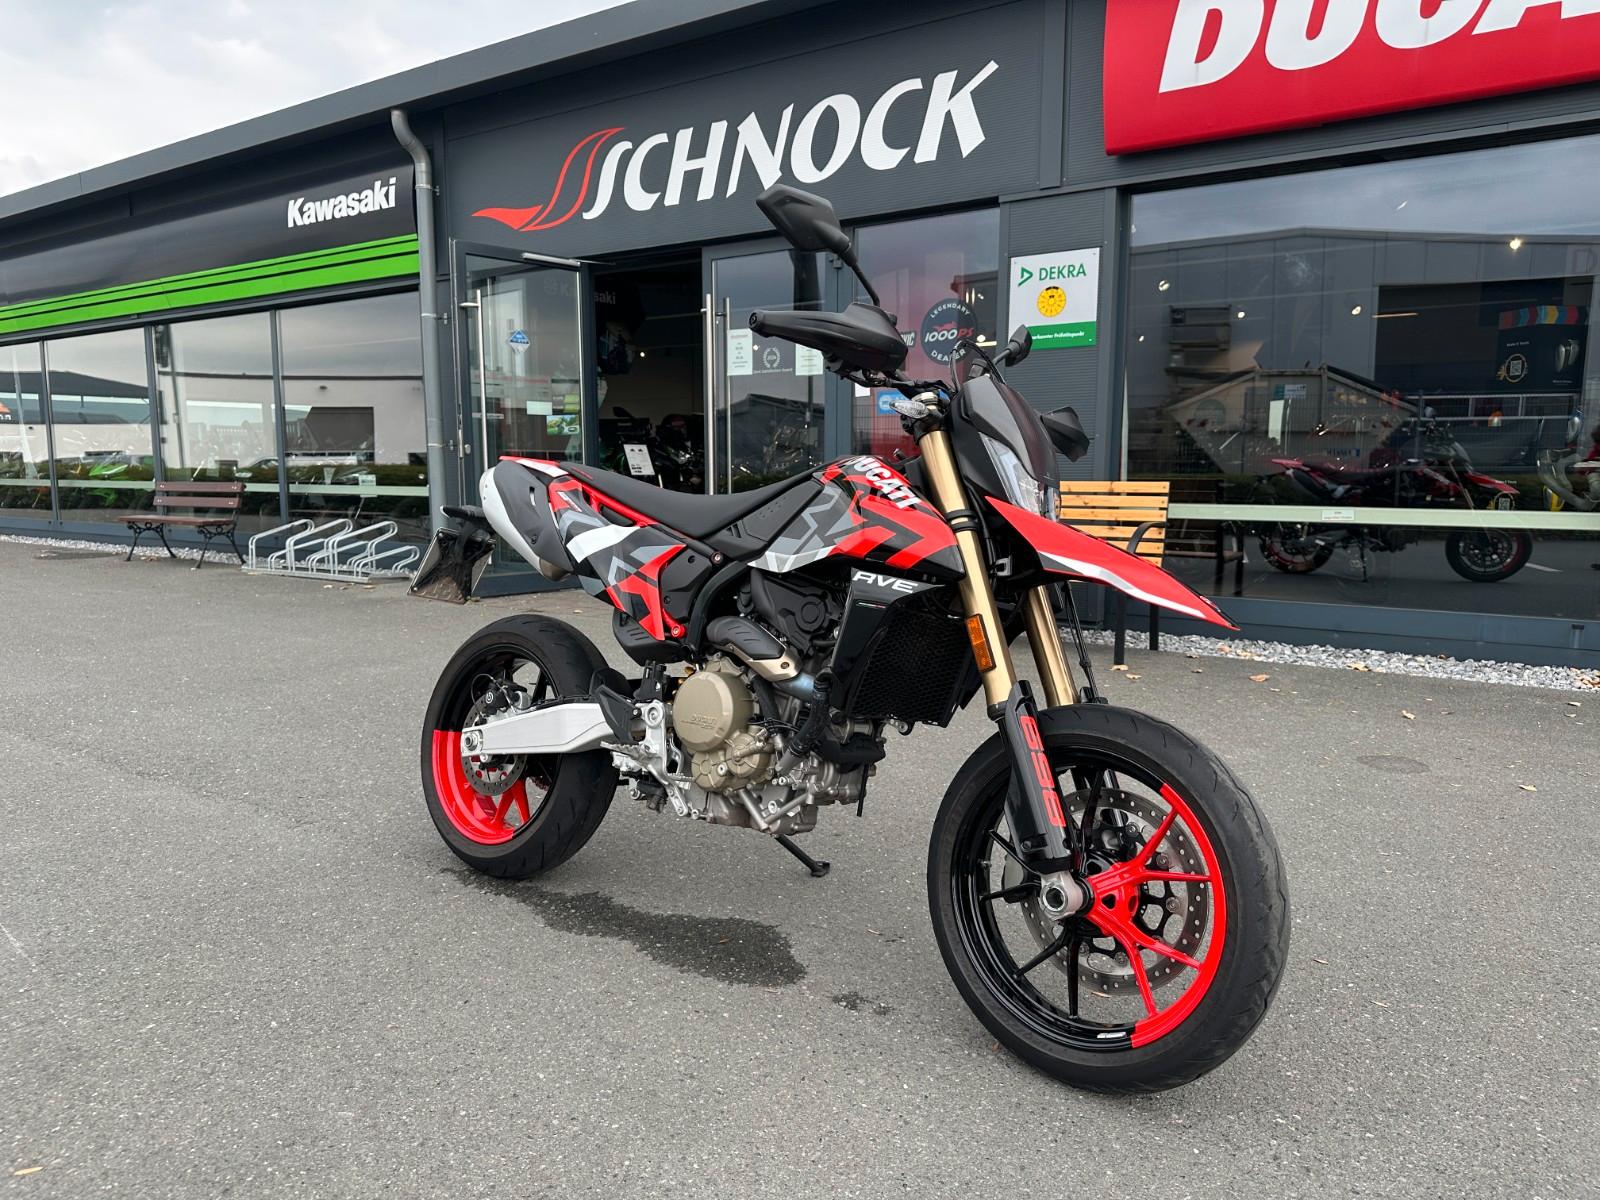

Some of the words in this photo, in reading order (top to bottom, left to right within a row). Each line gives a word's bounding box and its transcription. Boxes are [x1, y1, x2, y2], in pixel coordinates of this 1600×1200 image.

[1158, 0, 1600, 94] DU
[582, 60, 999, 220] SCHNOCK
[287, 177, 397, 228] Kawasaki
[1039, 263, 1087, 281] DEKRA
[930, 302, 971, 318] LEGENDARY
[931, 348, 967, 362] DEAER
